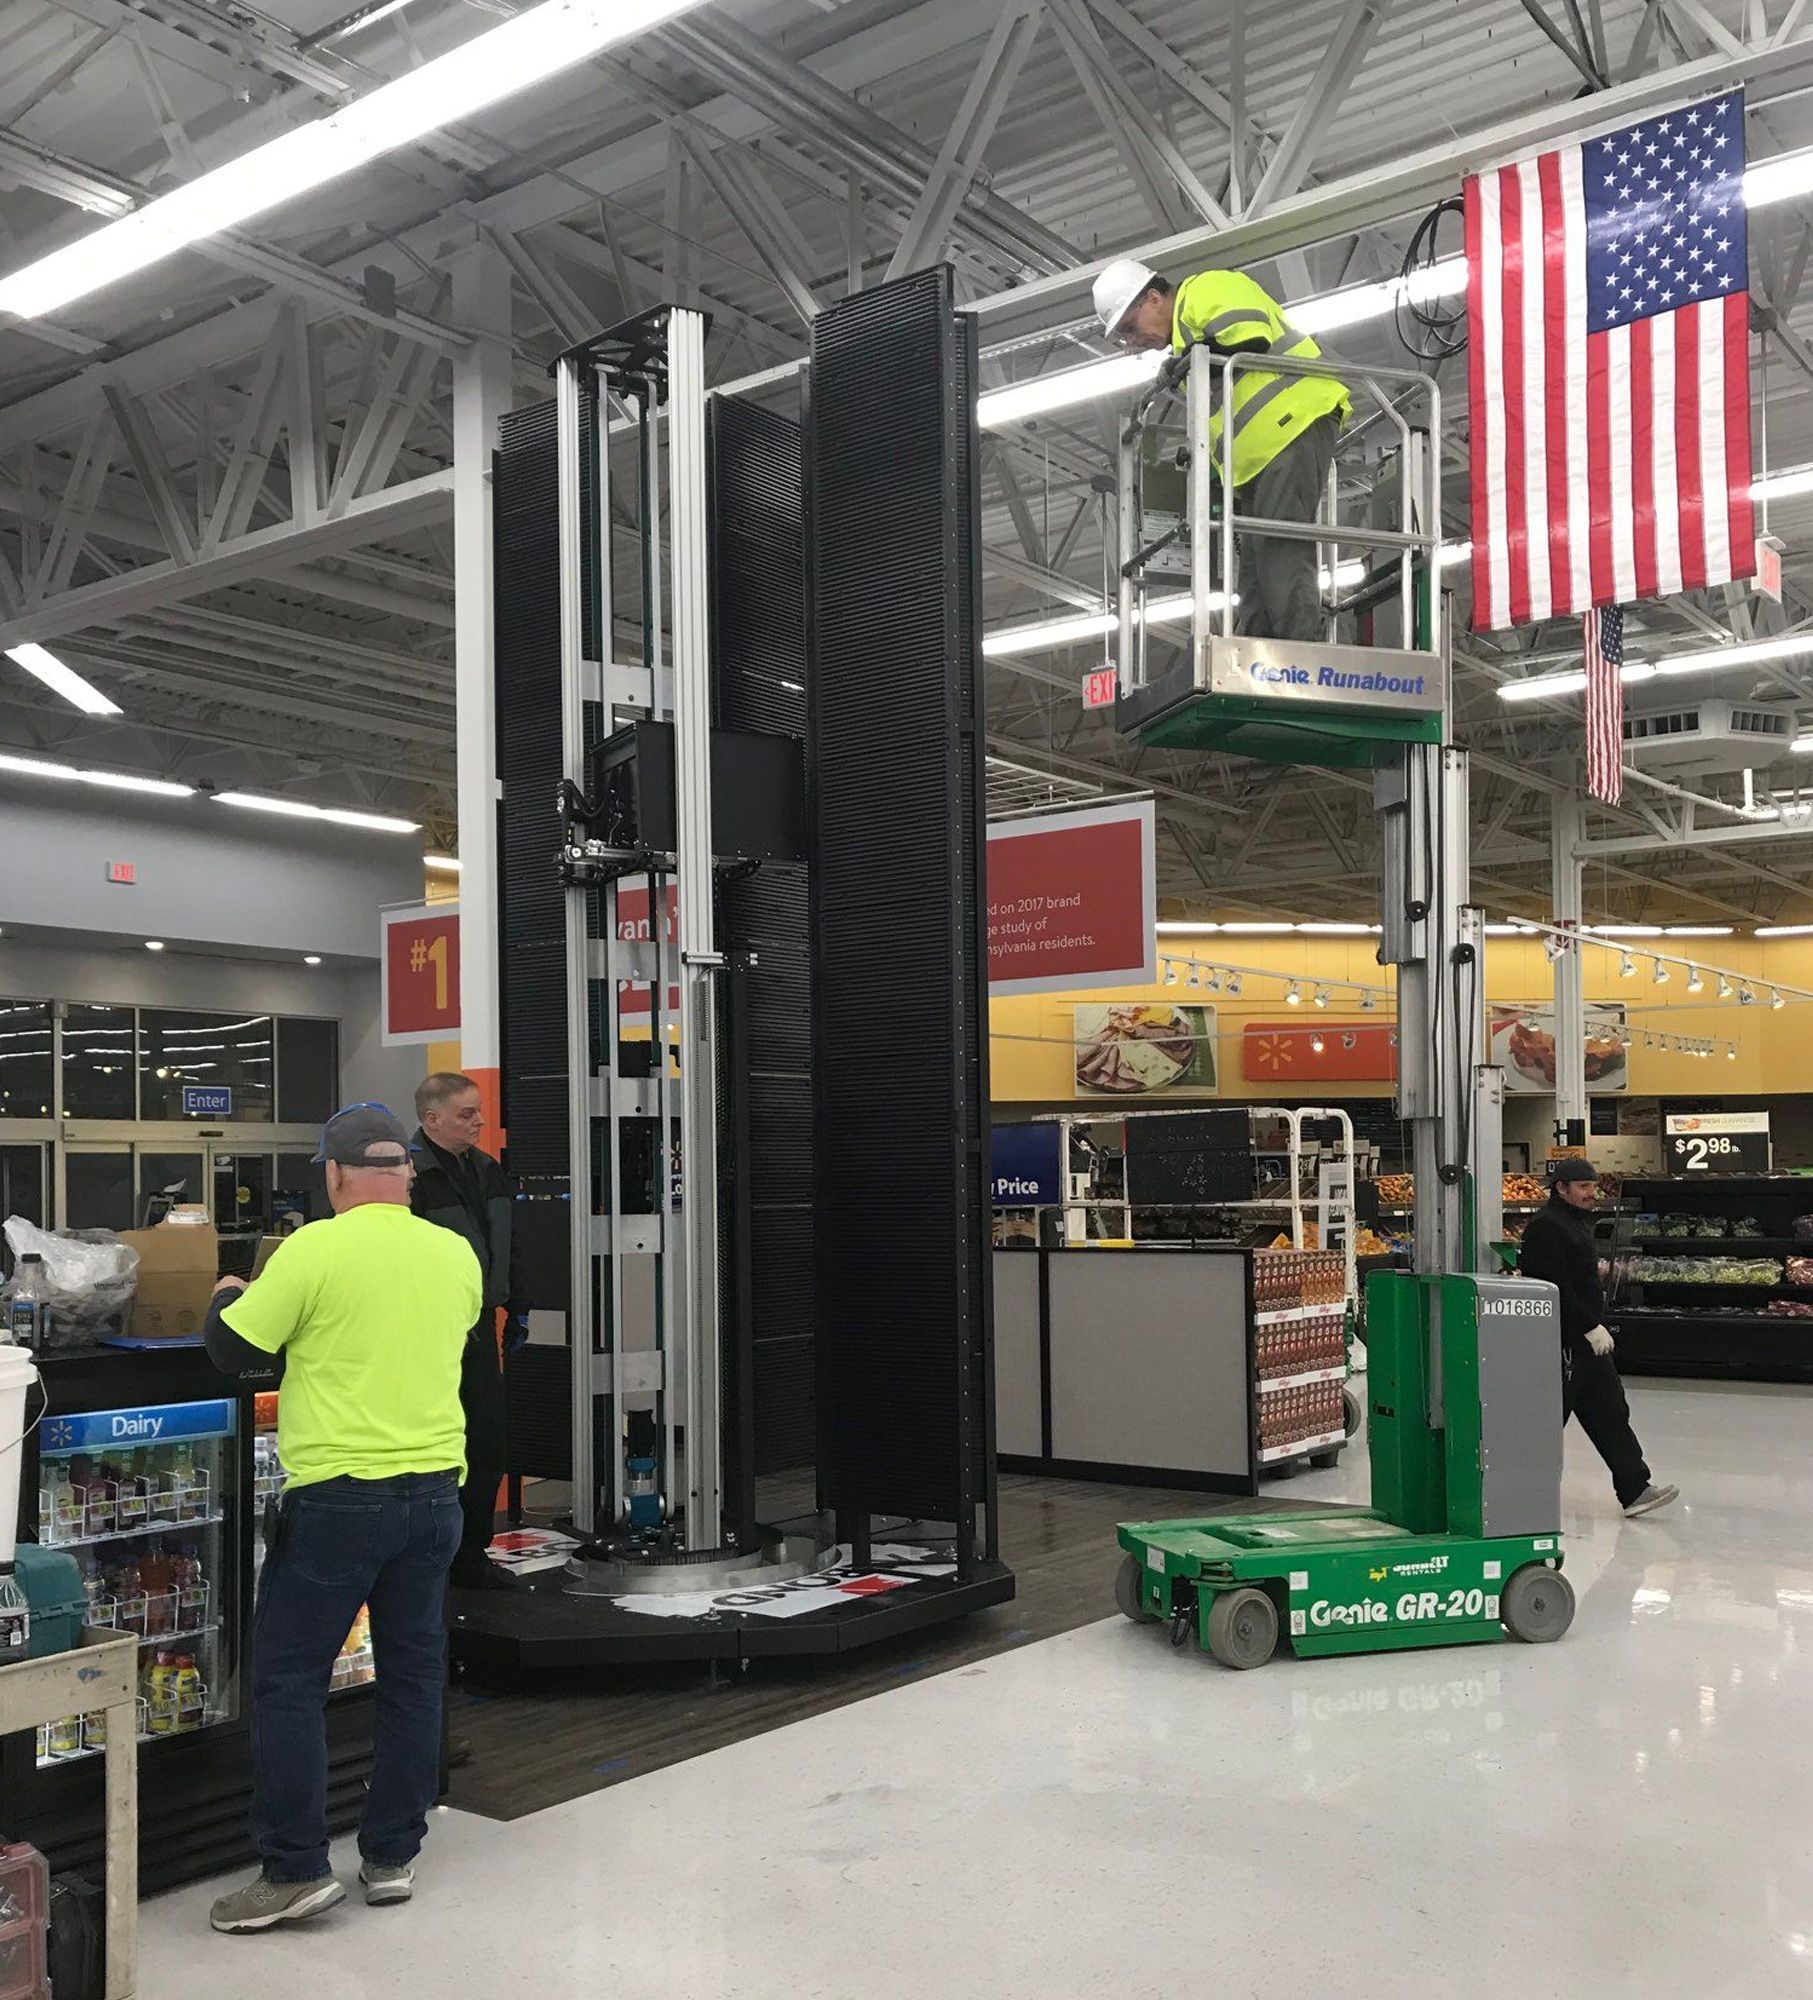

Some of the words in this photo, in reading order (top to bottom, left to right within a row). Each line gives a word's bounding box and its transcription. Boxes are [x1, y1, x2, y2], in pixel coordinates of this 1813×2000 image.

[1318, 666, 1424, 695] Runabout
[1001, 904, 1015, 915] on
[1018, 897, 1043, 913] 2017
[1047, 893, 1080, 909] brand
[1001, 920, 1032, 935] study
[1035, 917, 1049, 931] of
[1040, 934, 1096, 950] residents.
[410, 936, 447, 1010] #1
[188, 1092, 226, 1108] Enter
[997, 1177, 1039, 1195] Price
[1486, 1299, 1551, 1316] 1016866
[112, 1413, 163, 1438] Dairy
[1310, 1597, 1388, 1627] Genie
[1396, 1588, 1484, 1622] GR-20
